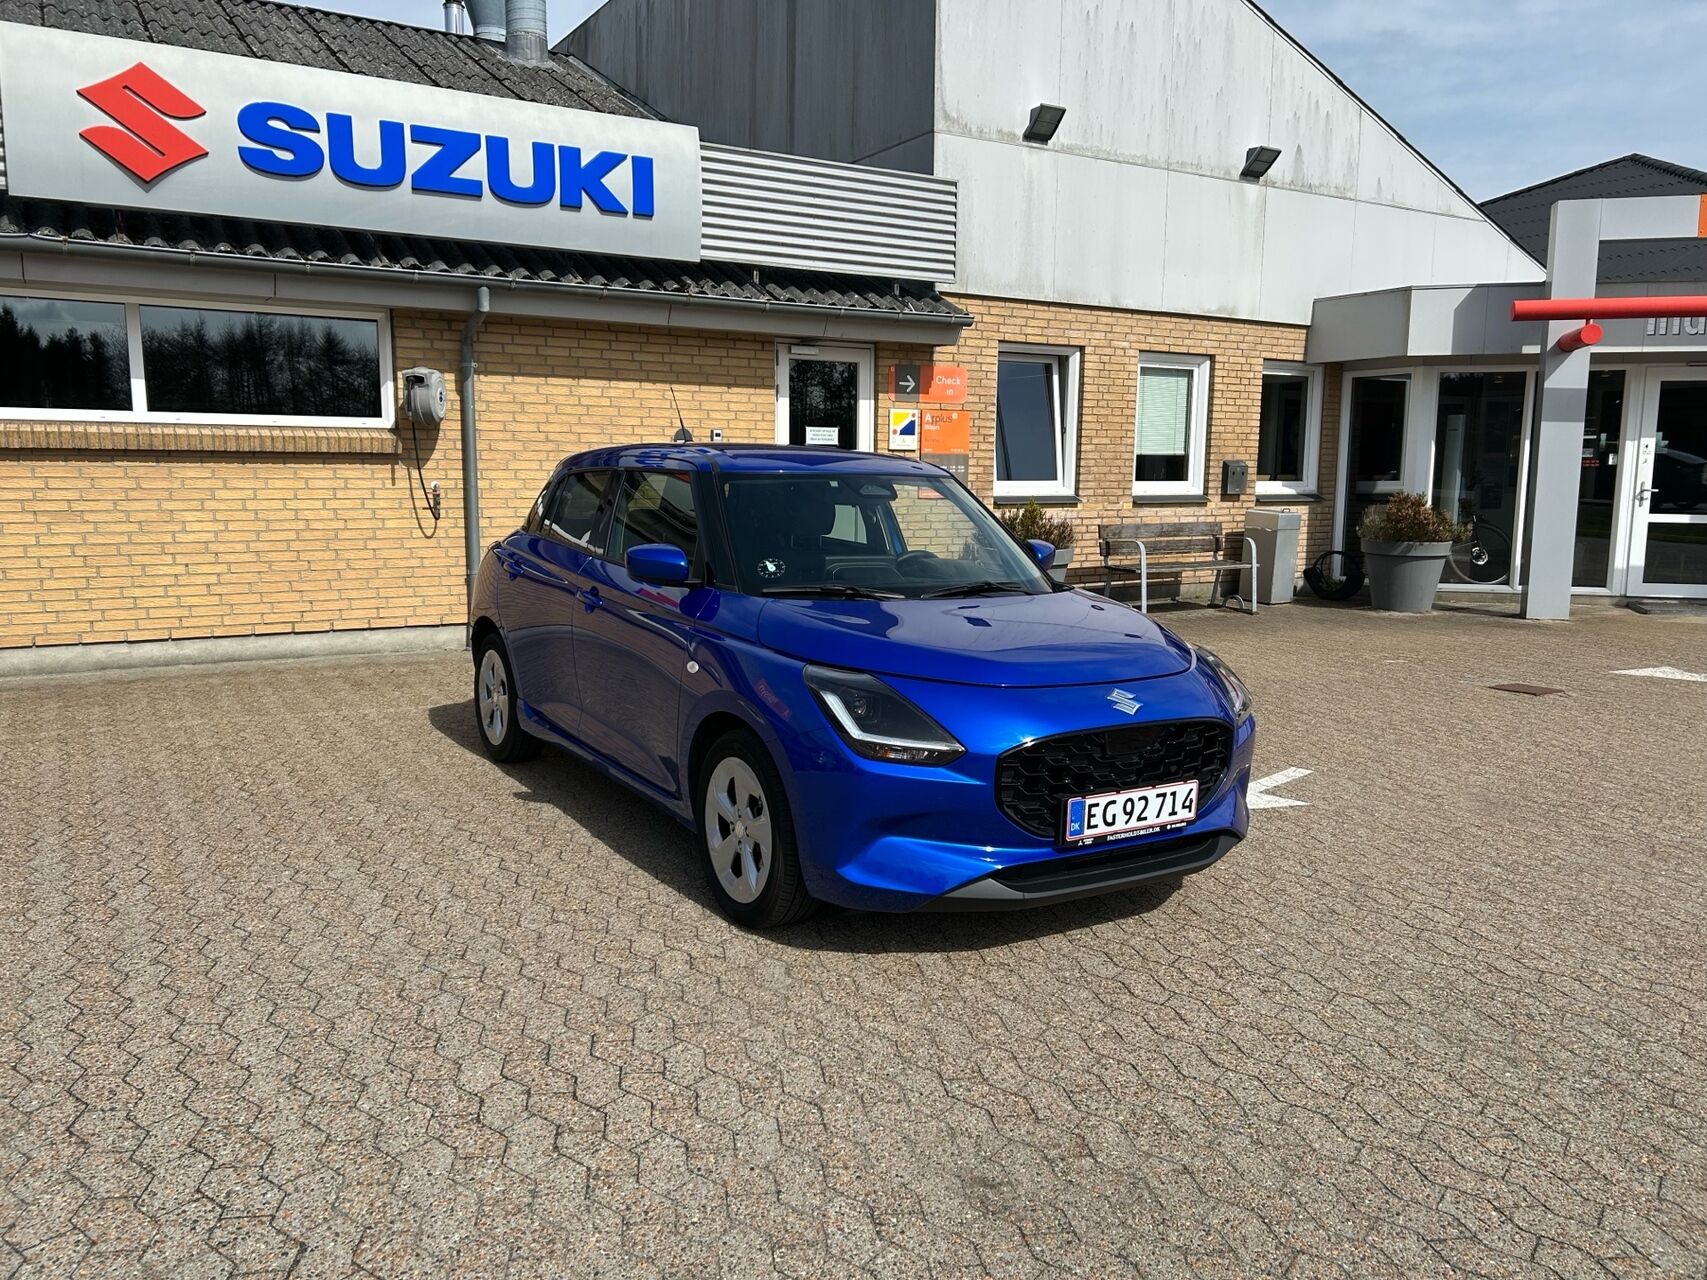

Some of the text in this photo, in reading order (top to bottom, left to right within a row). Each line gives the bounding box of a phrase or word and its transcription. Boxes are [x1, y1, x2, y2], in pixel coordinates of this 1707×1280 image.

[237, 101, 655, 218] SUZUKI
[936, 376, 960, 385] Check
[1071, 822, 1080, 831] DK
